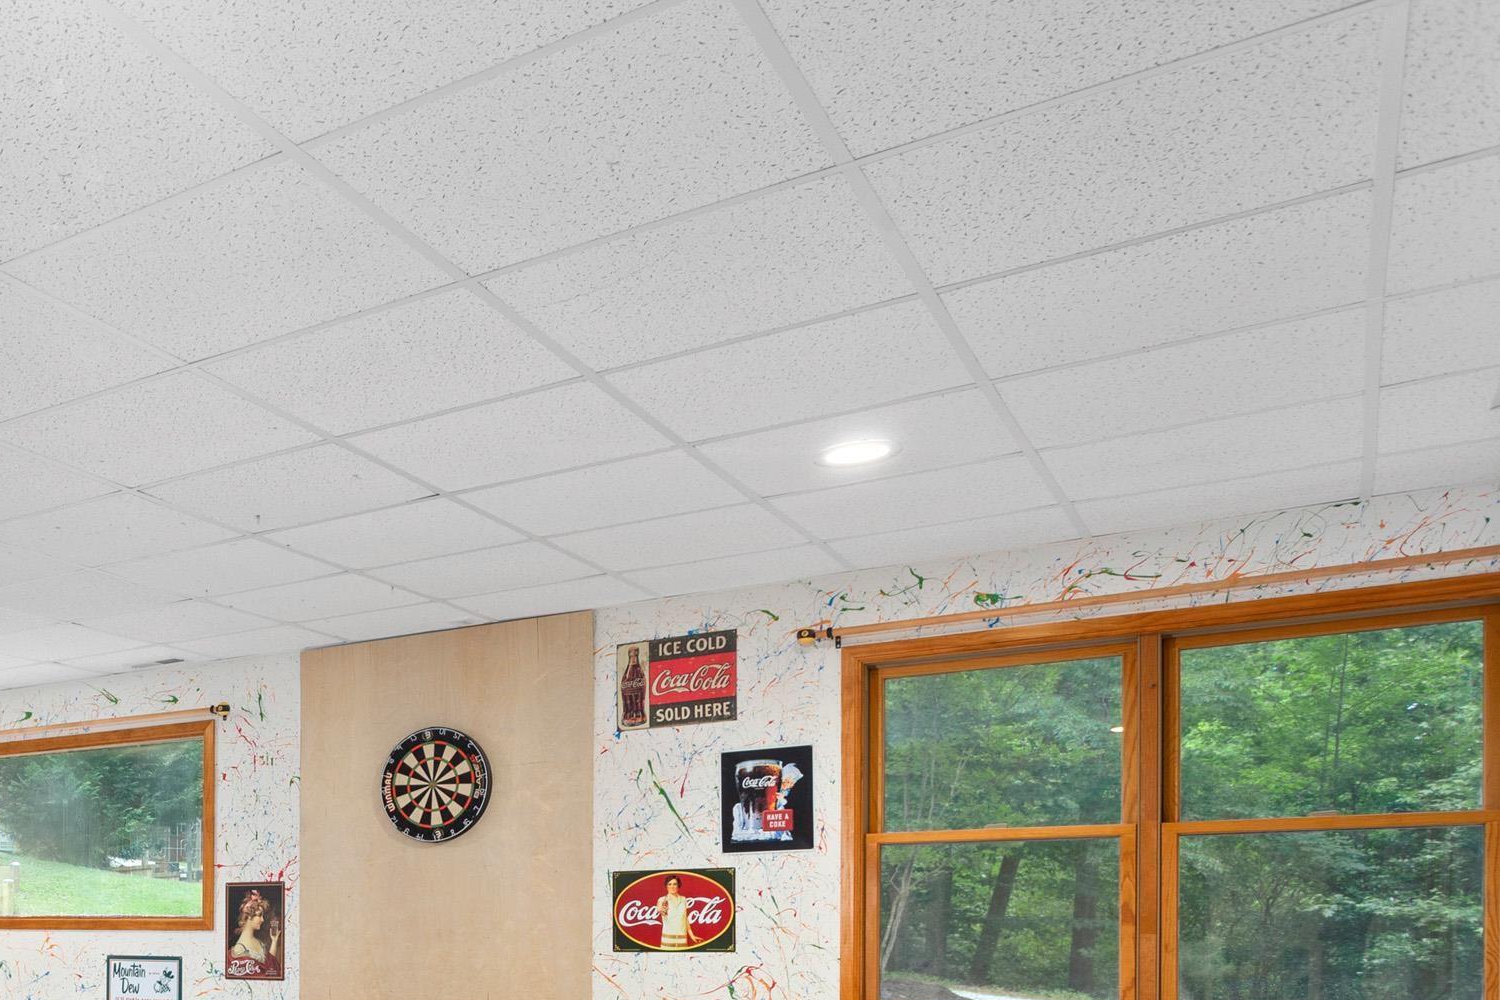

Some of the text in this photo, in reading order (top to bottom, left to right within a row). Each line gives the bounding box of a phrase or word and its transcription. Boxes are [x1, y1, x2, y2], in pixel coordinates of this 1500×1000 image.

[658, 635, 727, 657] ICE COLD
[656, 701, 731, 722] SOLD HERE
[766, 812, 790, 821] HAVE A
[769, 820, 786, 828] COKE
[618, 899, 663, 927] Coca
[112, 962, 146, 978] Mountain
[119, 977, 140, 994] Dew
